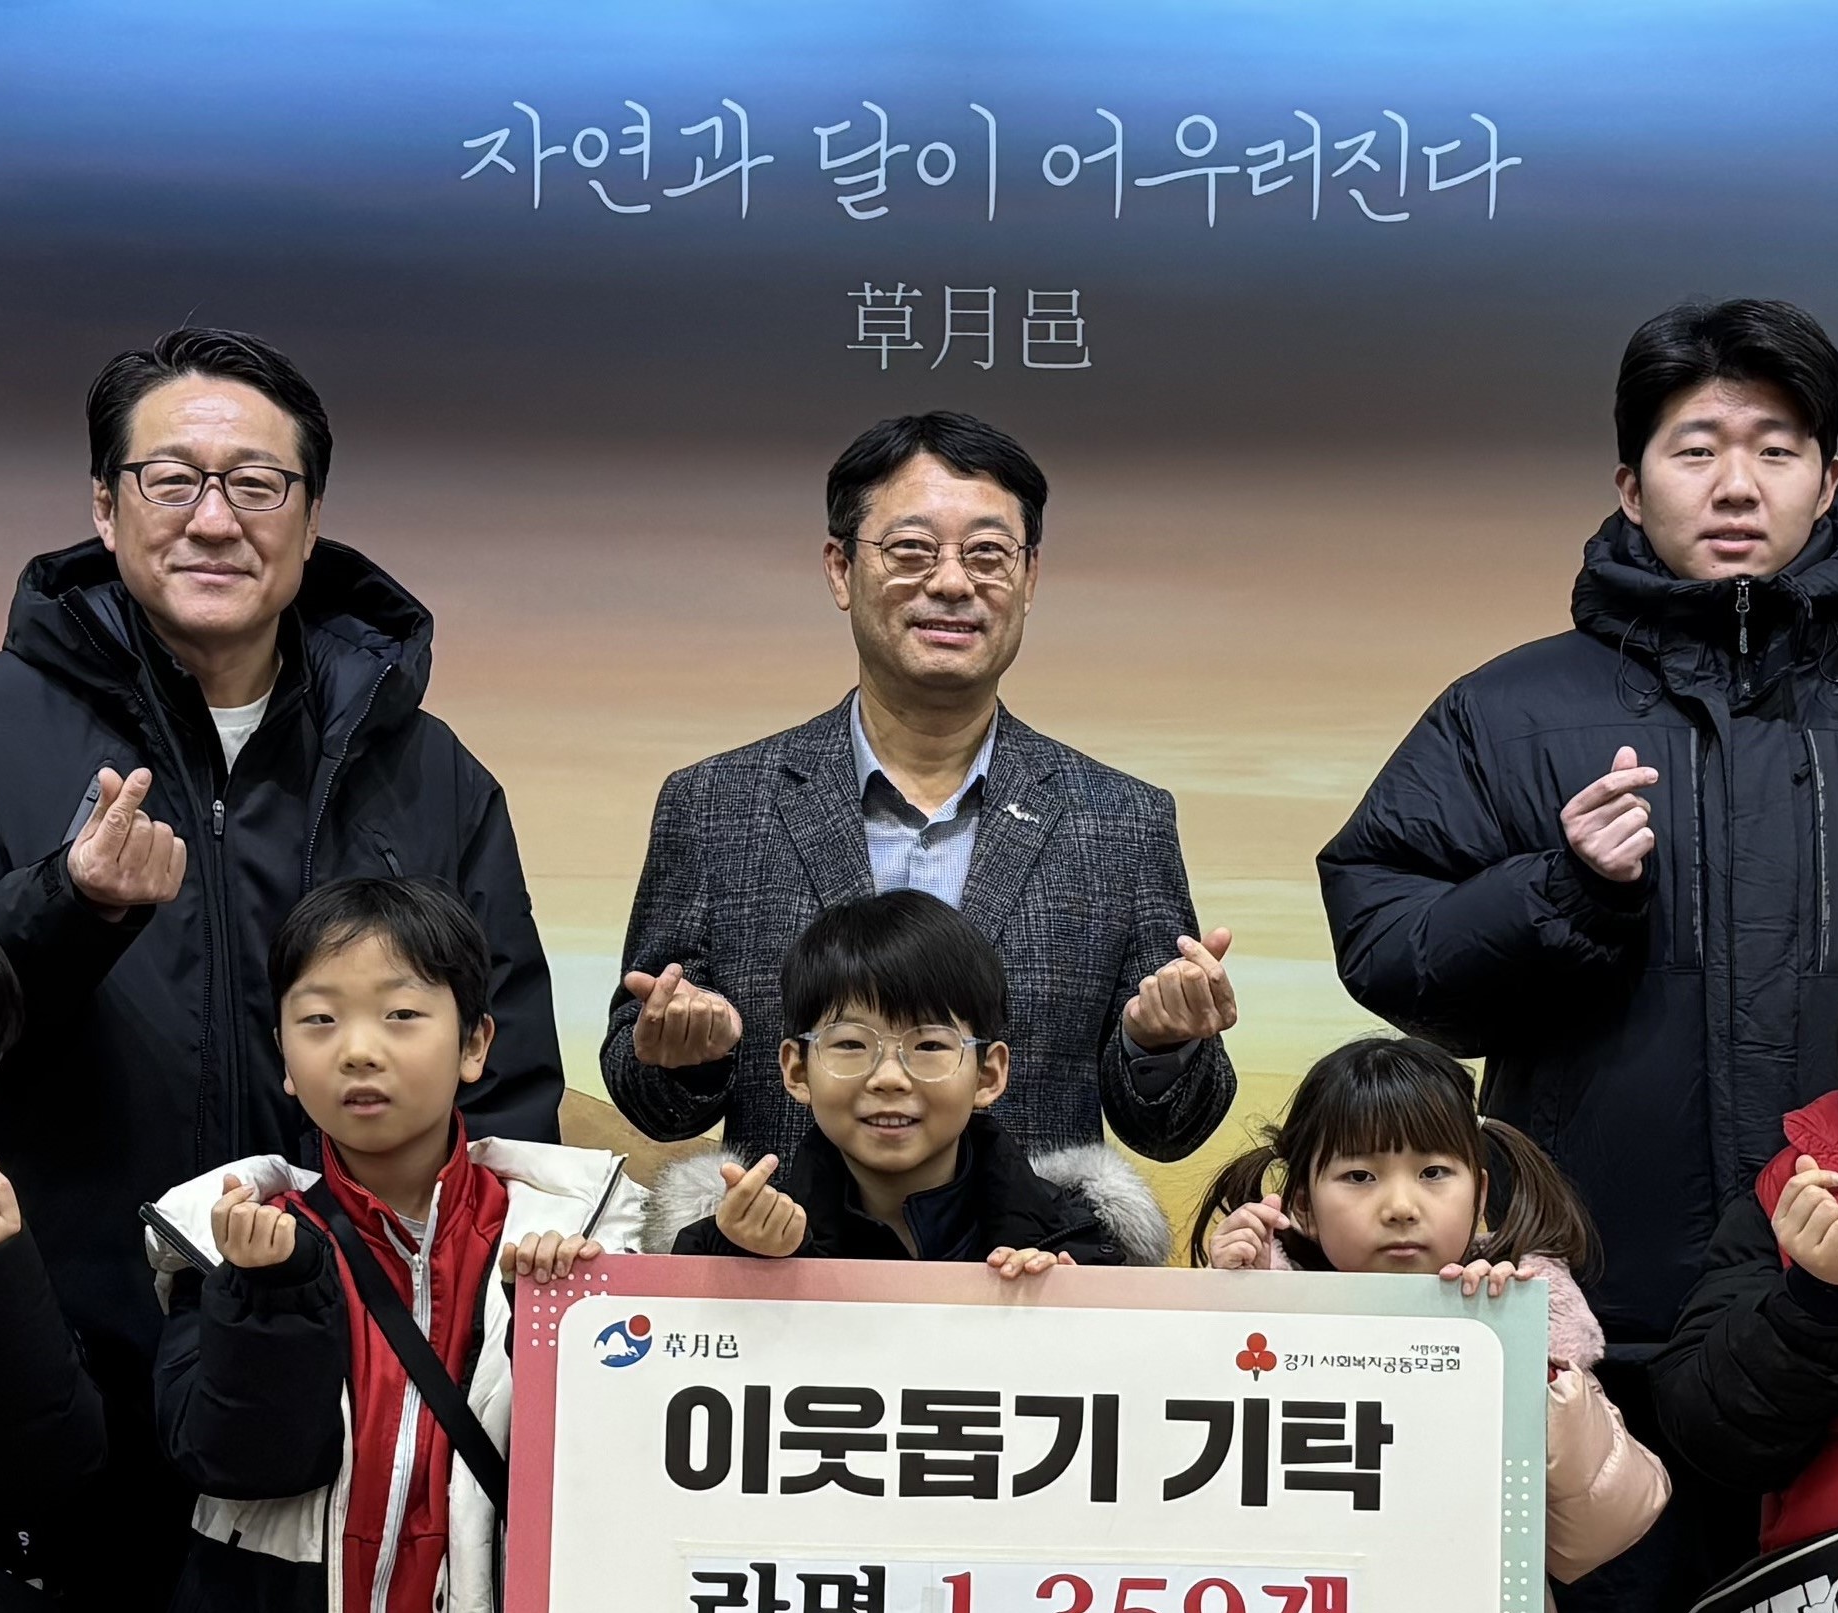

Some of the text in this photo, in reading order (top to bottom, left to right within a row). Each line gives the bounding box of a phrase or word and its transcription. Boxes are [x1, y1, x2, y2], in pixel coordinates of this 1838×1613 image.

[461, 99, 1521, 228] 자연과 달이 어우러진다
[846, 282, 1093, 371] 草月邑
[663, 1332, 740, 1361] 草月邑
[1284, 1354, 1314, 1371] 경기
[665, 1385, 1394, 1512] 이웃돕기 기탁
